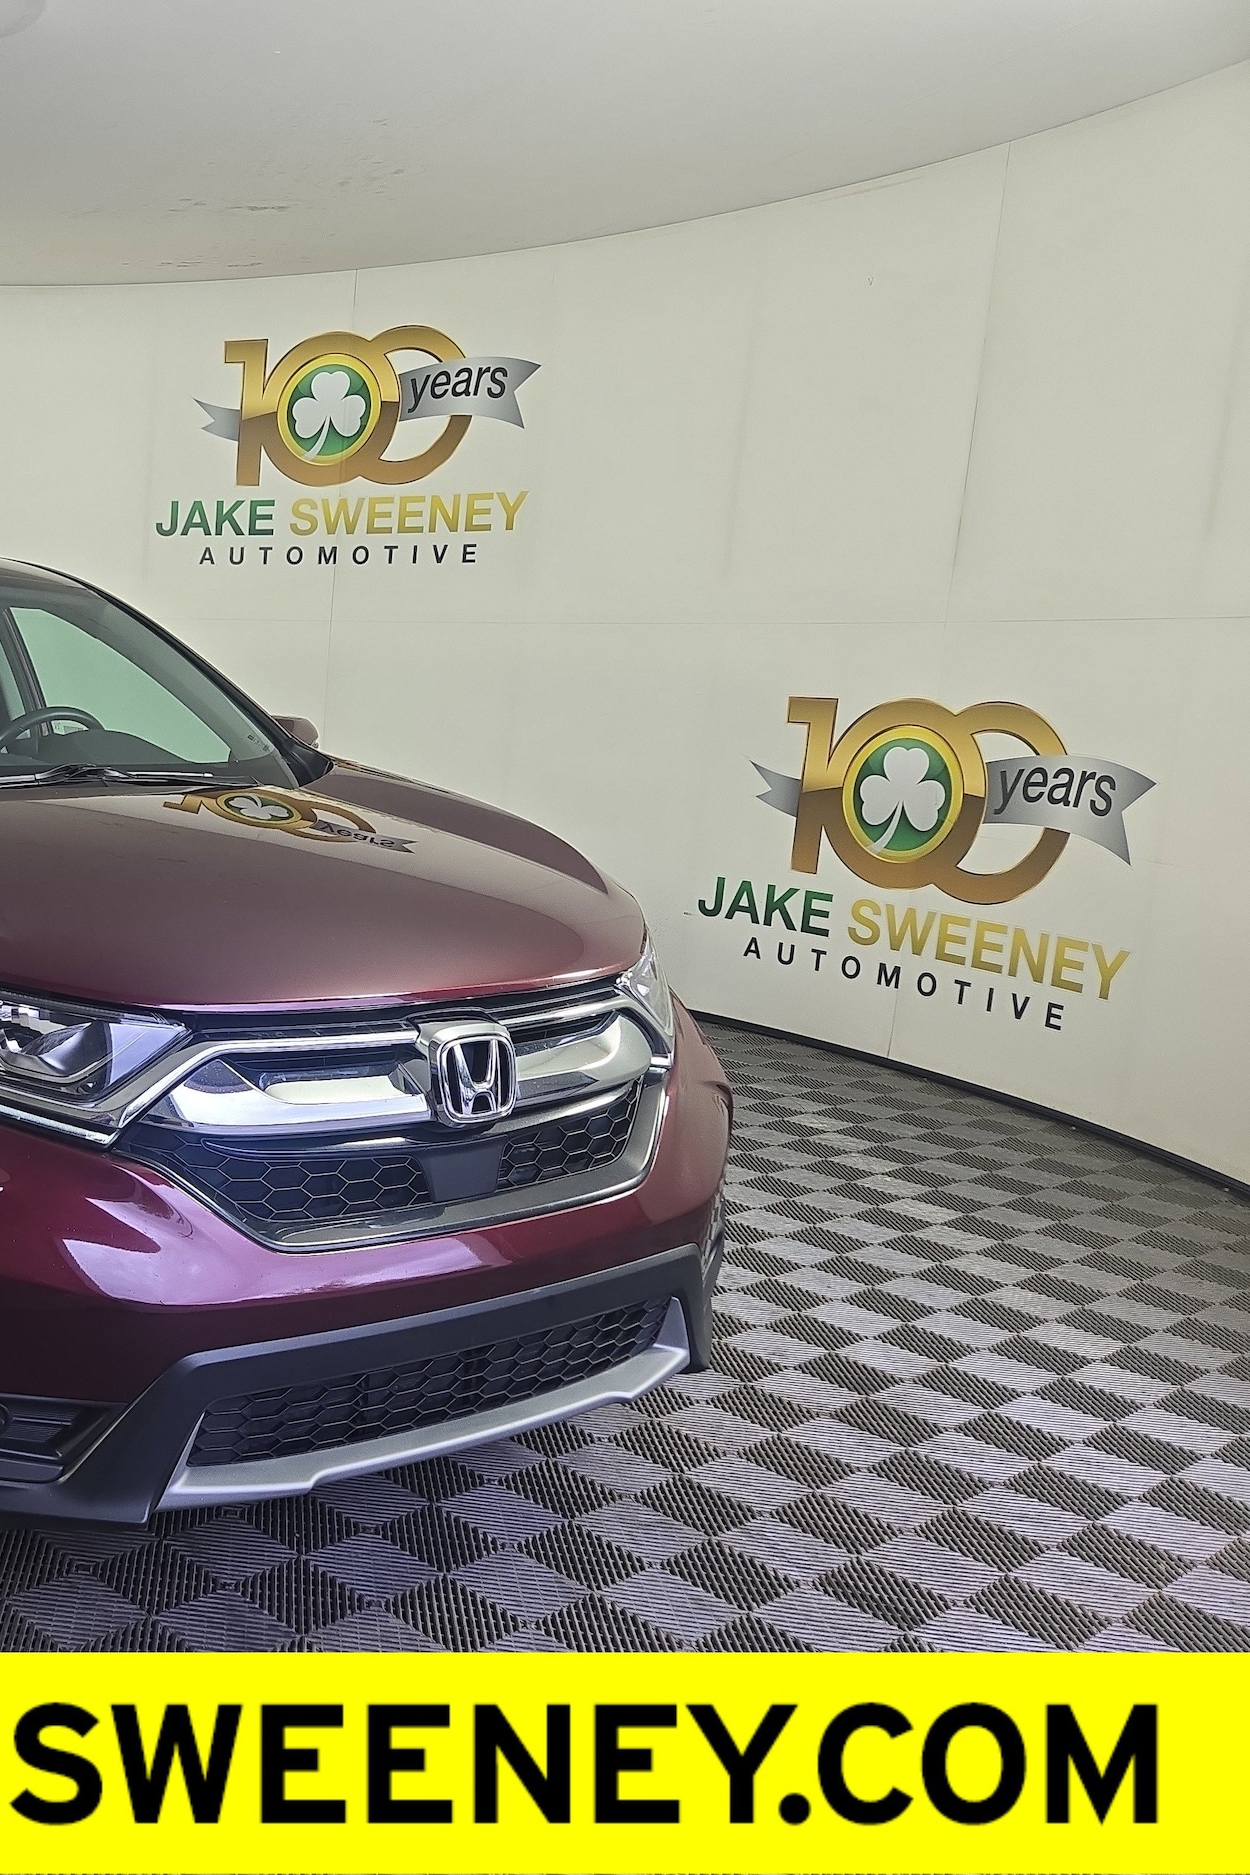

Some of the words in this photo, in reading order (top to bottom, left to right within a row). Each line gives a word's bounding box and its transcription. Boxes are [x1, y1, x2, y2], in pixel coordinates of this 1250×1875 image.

[224, 325, 473, 488] 100
[407, 365, 509, 413] years
[155, 499, 276, 538] JAKE
[289, 491, 530, 537] SWEENEY
[199, 543, 478, 566] AUTOMOTIVE
[787, 696, 1071, 905] 100
[993, 766, 1117, 817] years
[697, 876, 834, 938] JAKE
[847, 898, 1131, 1000] SWEENEY
[743, 937, 1065, 1031] AUTOMOTIVE
